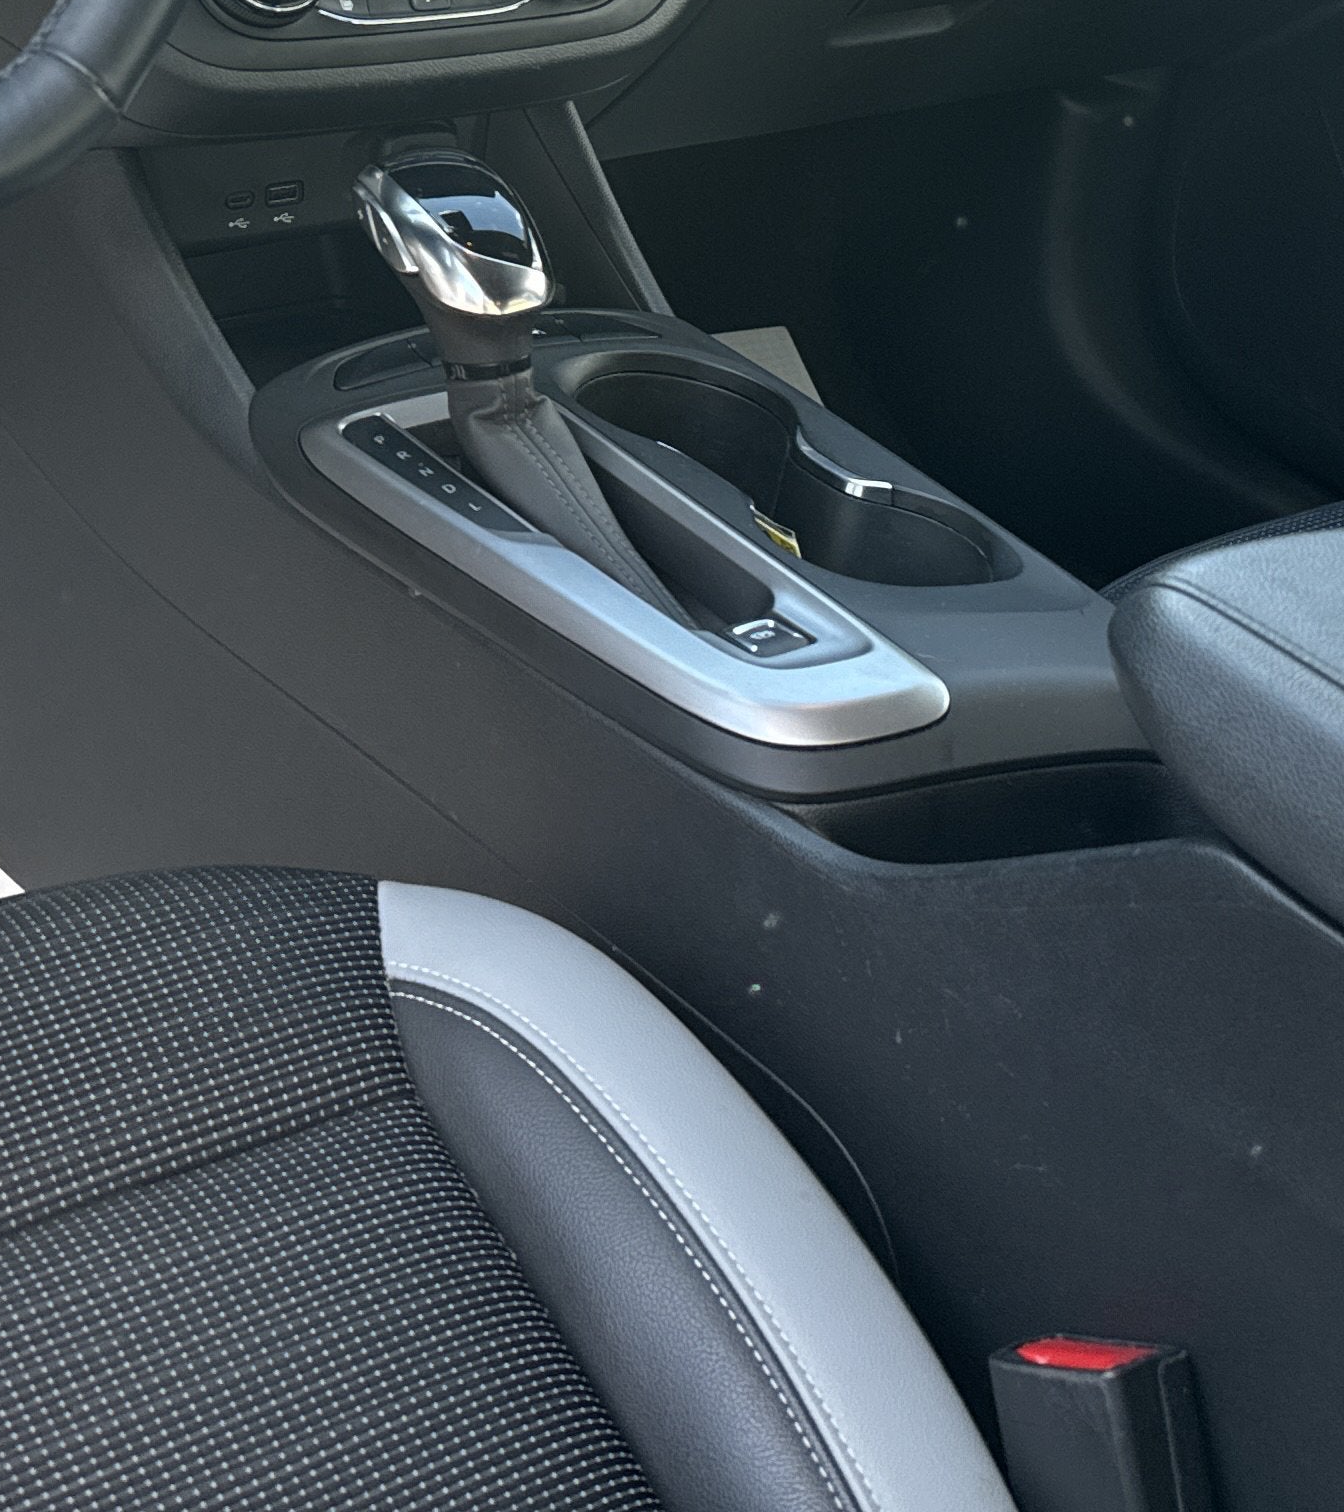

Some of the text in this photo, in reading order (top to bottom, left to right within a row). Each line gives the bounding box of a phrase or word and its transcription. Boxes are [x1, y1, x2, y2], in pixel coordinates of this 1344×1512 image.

[396, 450, 412, 460] R
[418, 467, 434, 477] N
[441, 483, 457, 494] D
